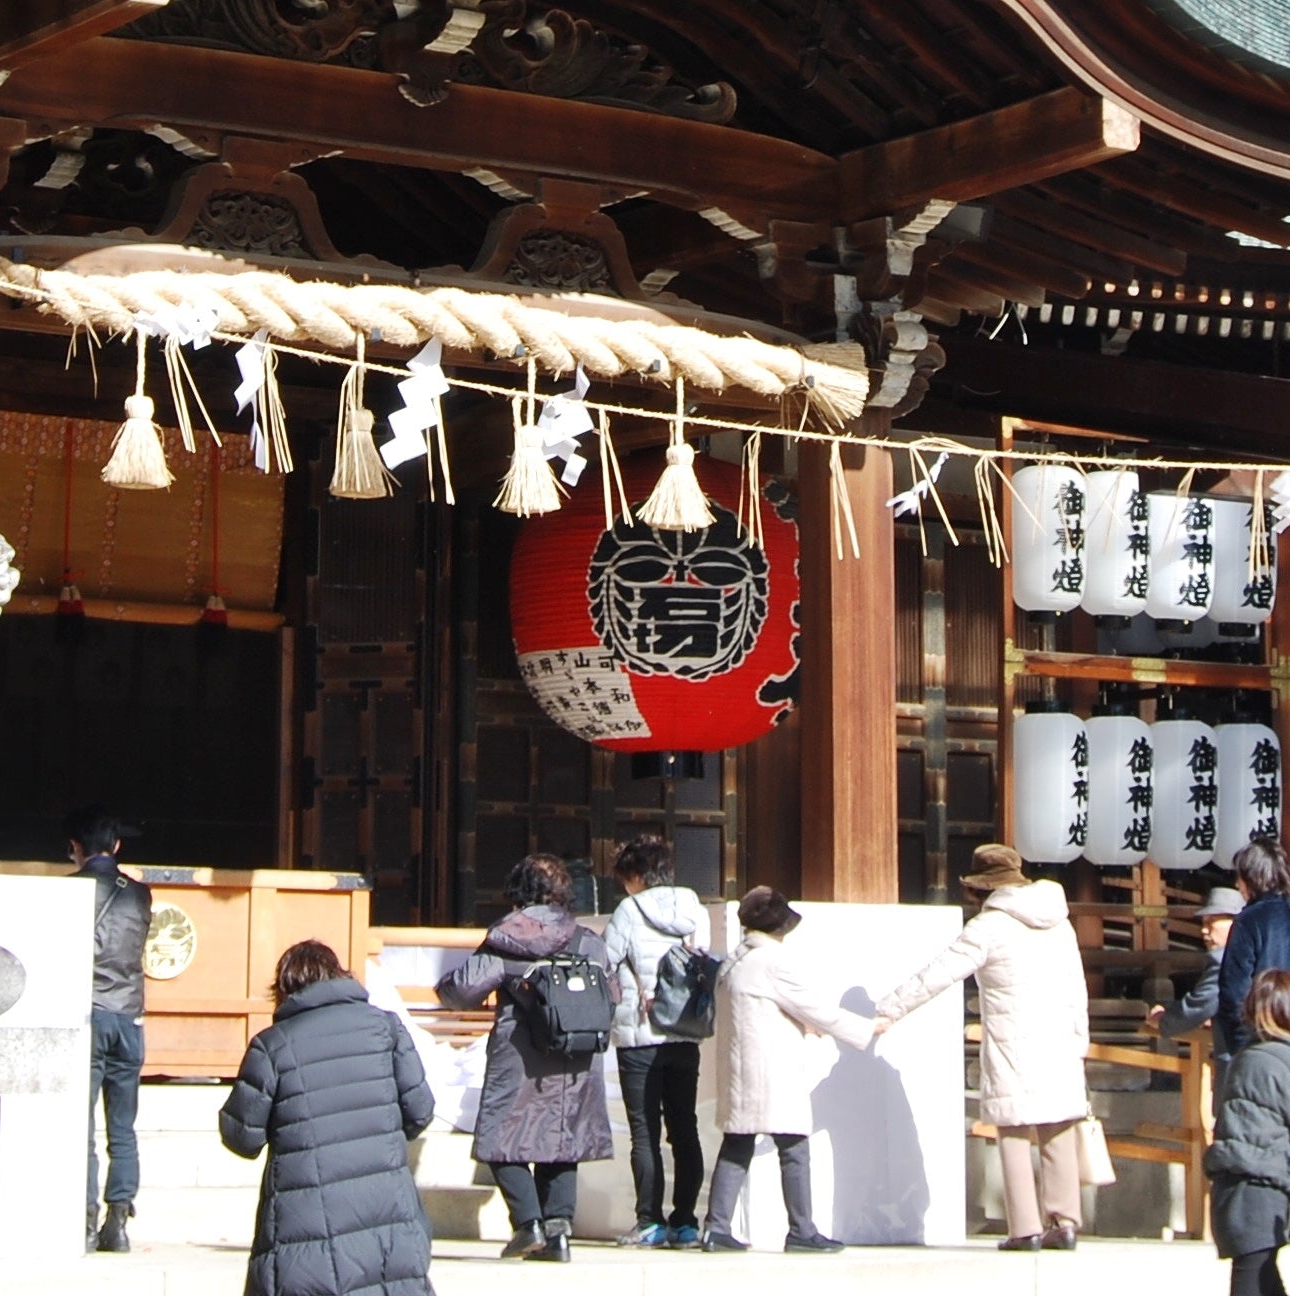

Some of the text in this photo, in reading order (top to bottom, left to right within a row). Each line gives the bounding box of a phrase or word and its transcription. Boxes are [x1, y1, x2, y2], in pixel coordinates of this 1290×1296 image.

[1050, 479, 1085, 593] 御神燈
[1176, 497, 1215, 608] 御神燈
[1121, 736, 1155, 853] 御神燈
[1183, 735, 1218, 852] 御神燈
